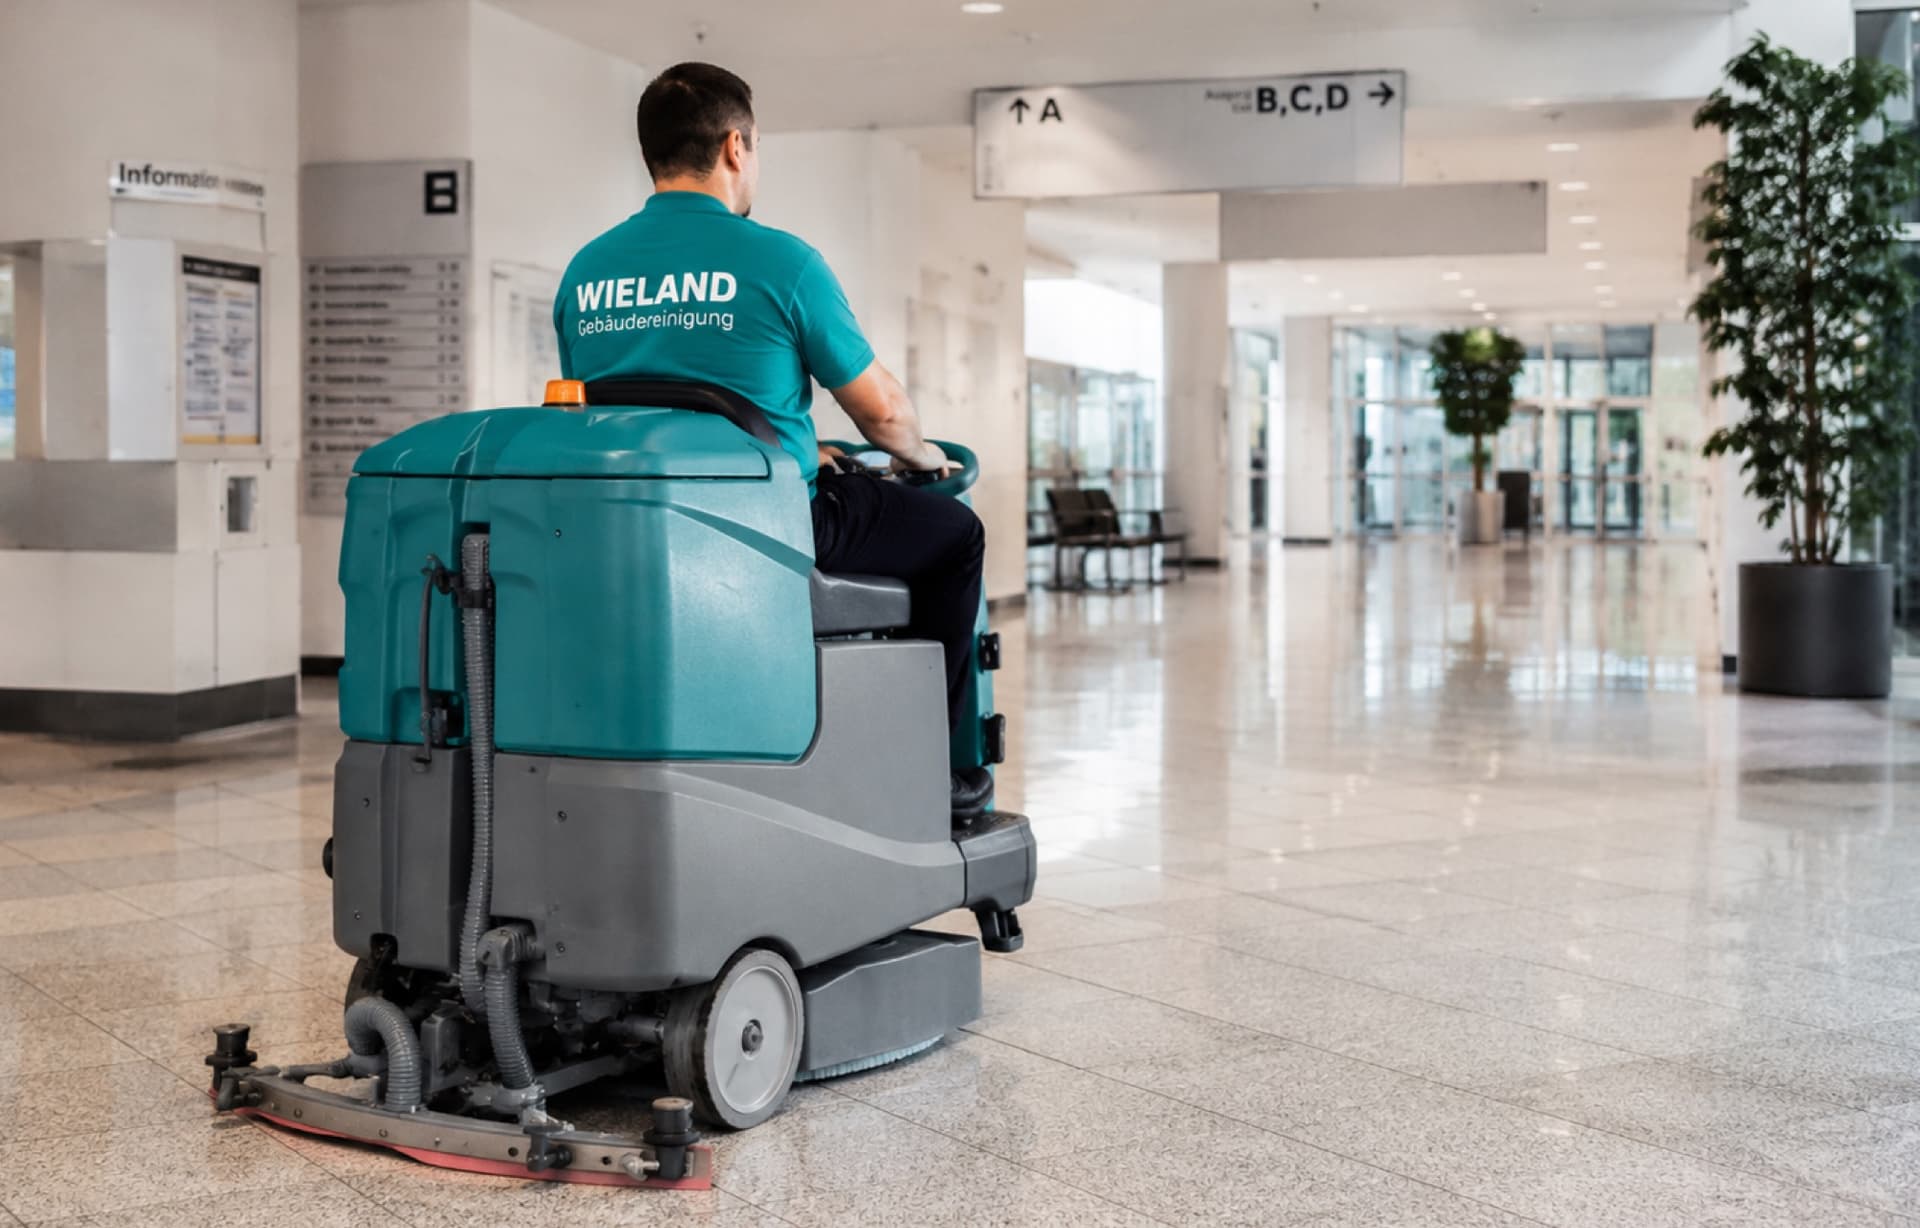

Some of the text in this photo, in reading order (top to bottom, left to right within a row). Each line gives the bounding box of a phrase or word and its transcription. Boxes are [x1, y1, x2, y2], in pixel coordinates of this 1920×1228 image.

[1040, 97, 1062, 122] A
[1256, 82, 1349, 117] B,C,D
[424, 170, 458, 215] B
[576, 271, 737, 313] WIELAND
[578, 308, 734, 337] Gebäudereinigung
